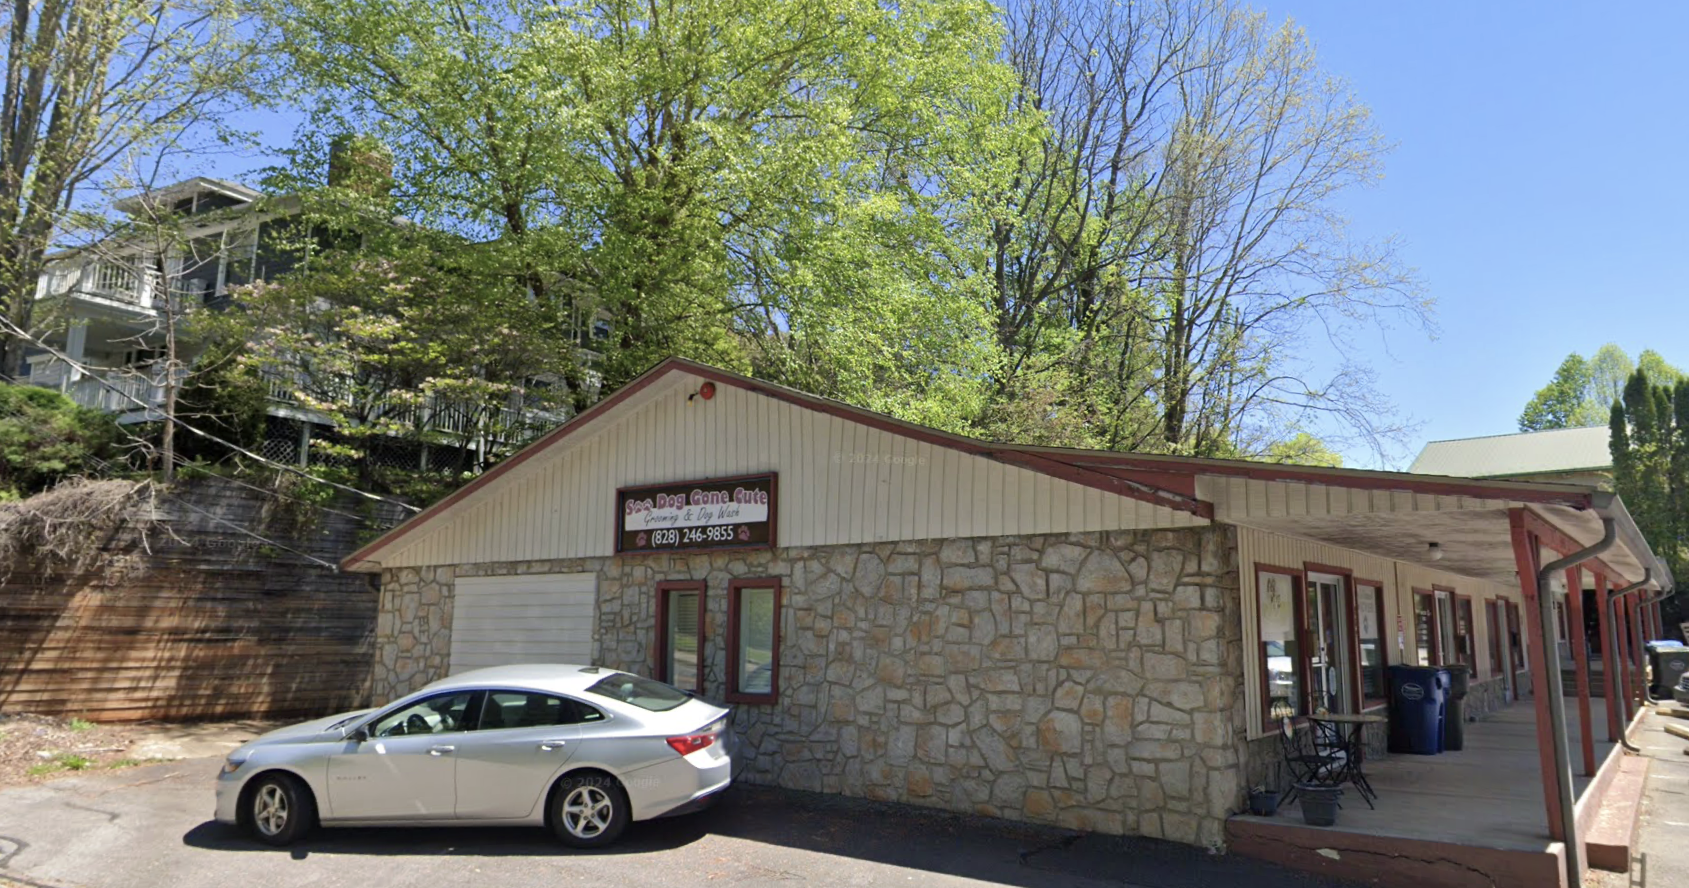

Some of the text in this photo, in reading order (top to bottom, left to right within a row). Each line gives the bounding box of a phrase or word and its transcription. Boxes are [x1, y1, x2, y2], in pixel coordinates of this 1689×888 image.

[656, 493, 686, 511] Dog
[690, 489, 730, 506] Gone
[733, 486, 768, 505] Cute
[643, 504, 740, 527] Grooming & Dog Wash
[651, 525, 734, 548] (828) 246-9855
